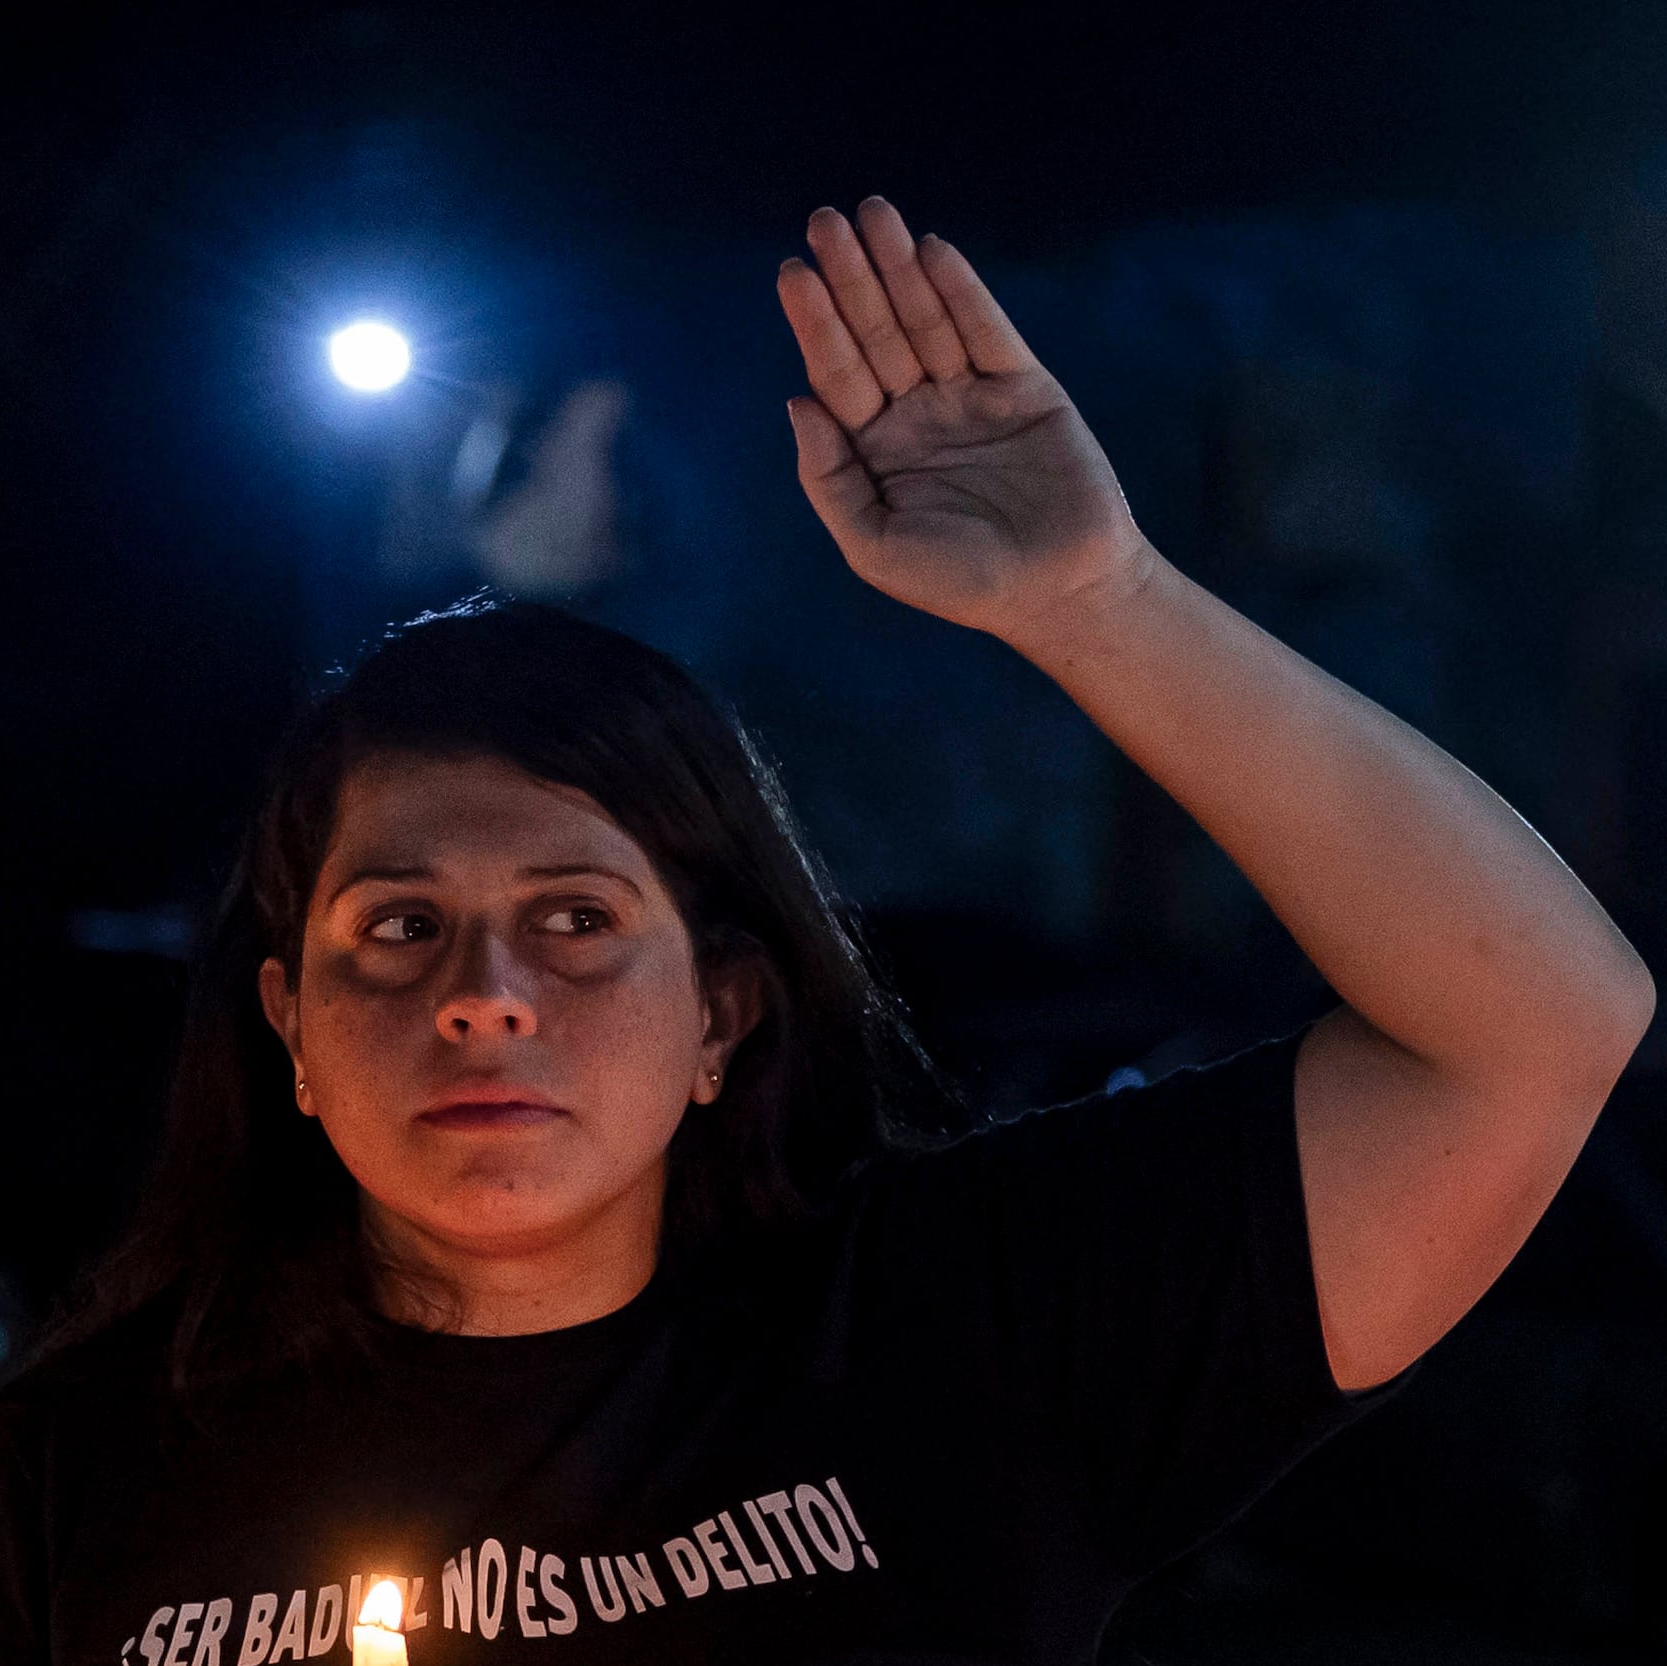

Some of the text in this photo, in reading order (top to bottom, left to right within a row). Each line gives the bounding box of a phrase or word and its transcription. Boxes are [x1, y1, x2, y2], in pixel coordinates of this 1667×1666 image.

[441, 1537, 508, 1640] NO
[517, 1545, 578, 1638] ES
[580, 1552, 666, 1623] UN
[662, 1476, 880, 1598] DELITO!
